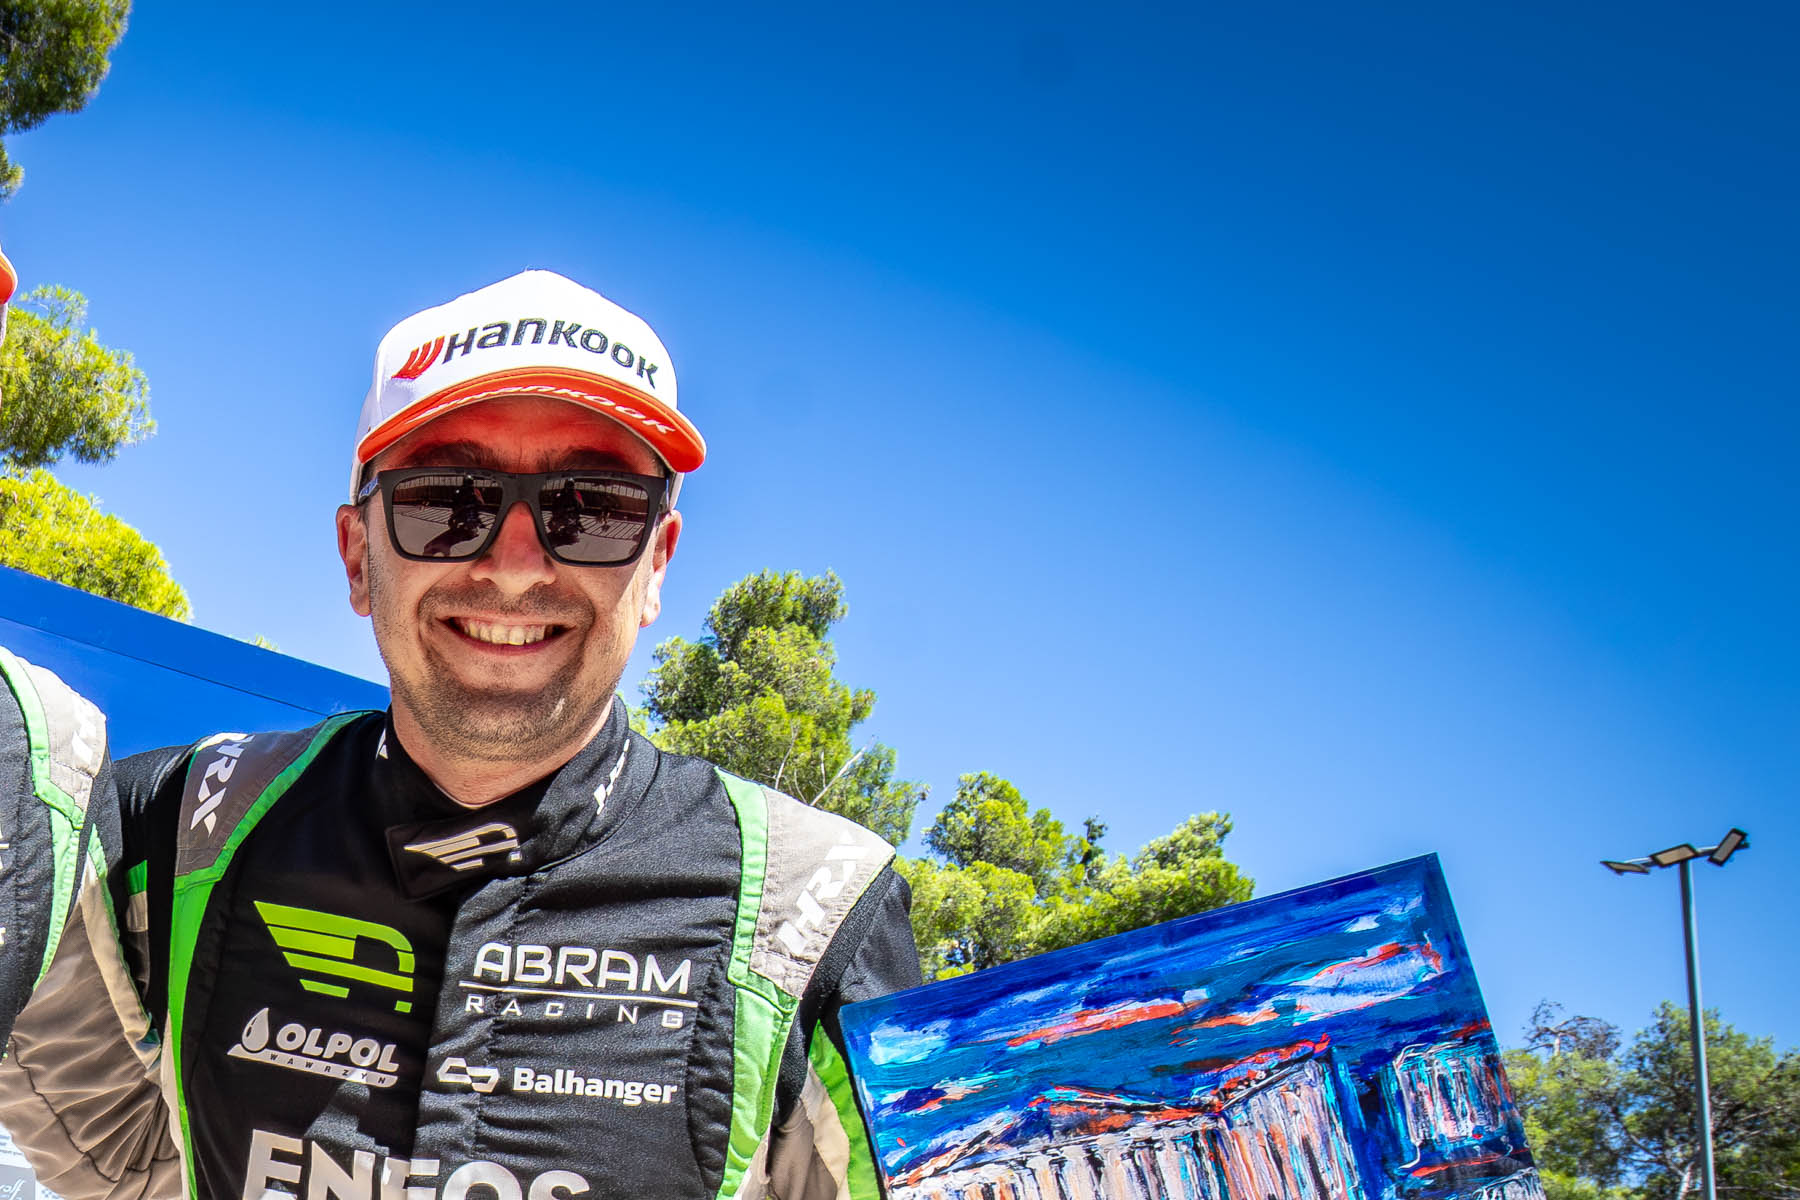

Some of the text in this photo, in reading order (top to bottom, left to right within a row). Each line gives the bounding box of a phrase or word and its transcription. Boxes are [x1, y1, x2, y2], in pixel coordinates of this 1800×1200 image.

[472, 941, 693, 995] ABRAM
[465, 995, 685, 1029] RACING
[276, 1022, 401, 1074] OLPOL
[270, 1051, 388, 1085] WAWRZYN
[513, 1068, 678, 1106] Balhanger
